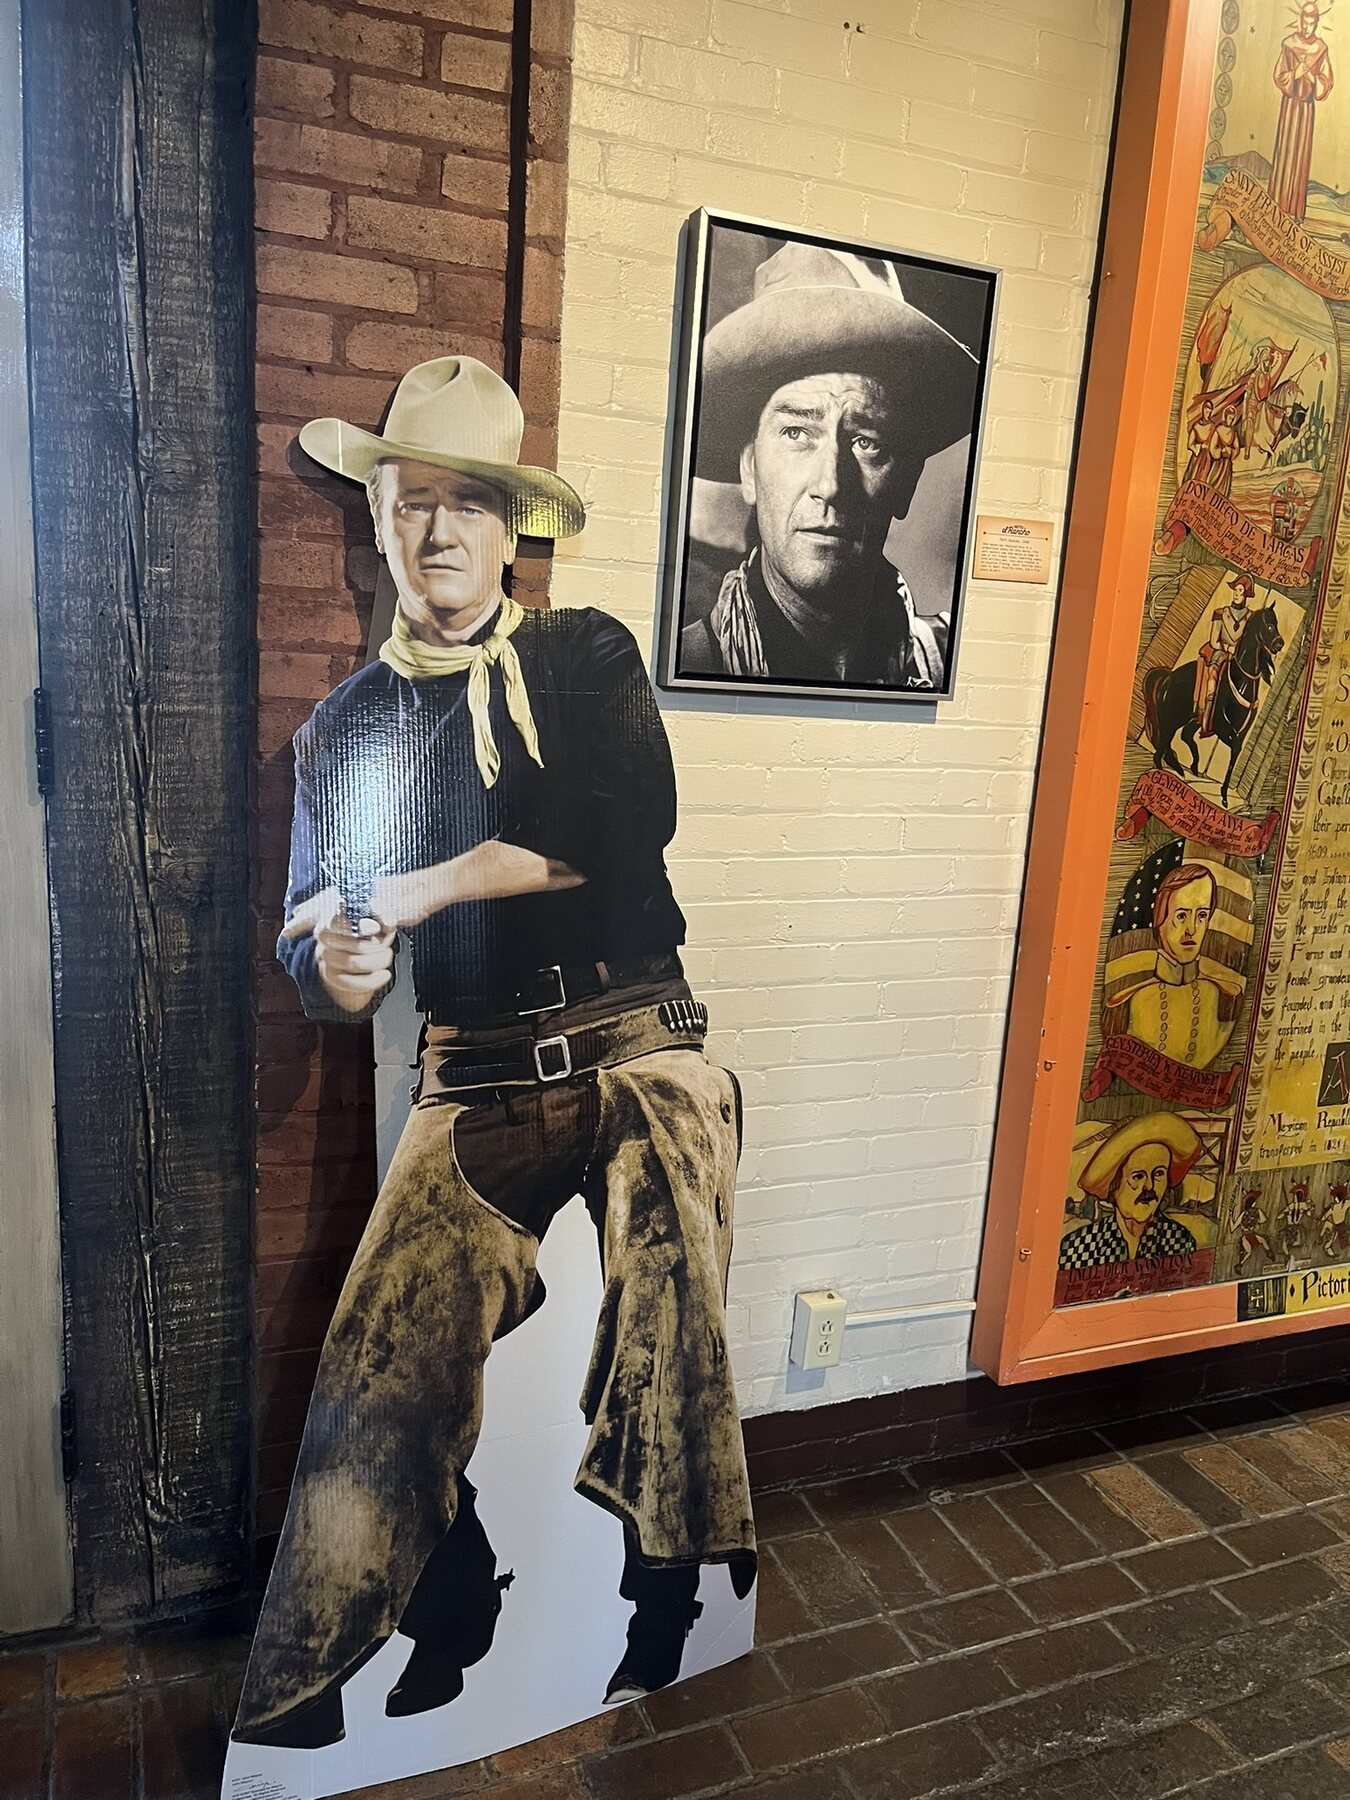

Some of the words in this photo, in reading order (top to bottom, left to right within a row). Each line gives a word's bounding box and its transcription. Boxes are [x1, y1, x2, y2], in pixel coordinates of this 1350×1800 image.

[1225, 169, 1257, 196] SAINT
[1256, 190, 1299, 242] FRANCIS
[1300, 235, 1315, 253] OF
[1314, 248, 1346, 275] ASSISI
[1209, 492, 1240, 526] DIEGO
[1240, 521, 1257, 541] DE
[1262, 533, 1304, 563] VARGAS
[1150, 770, 1190, 804] GENERAL
[1190, 795, 1218, 821] SANTA
